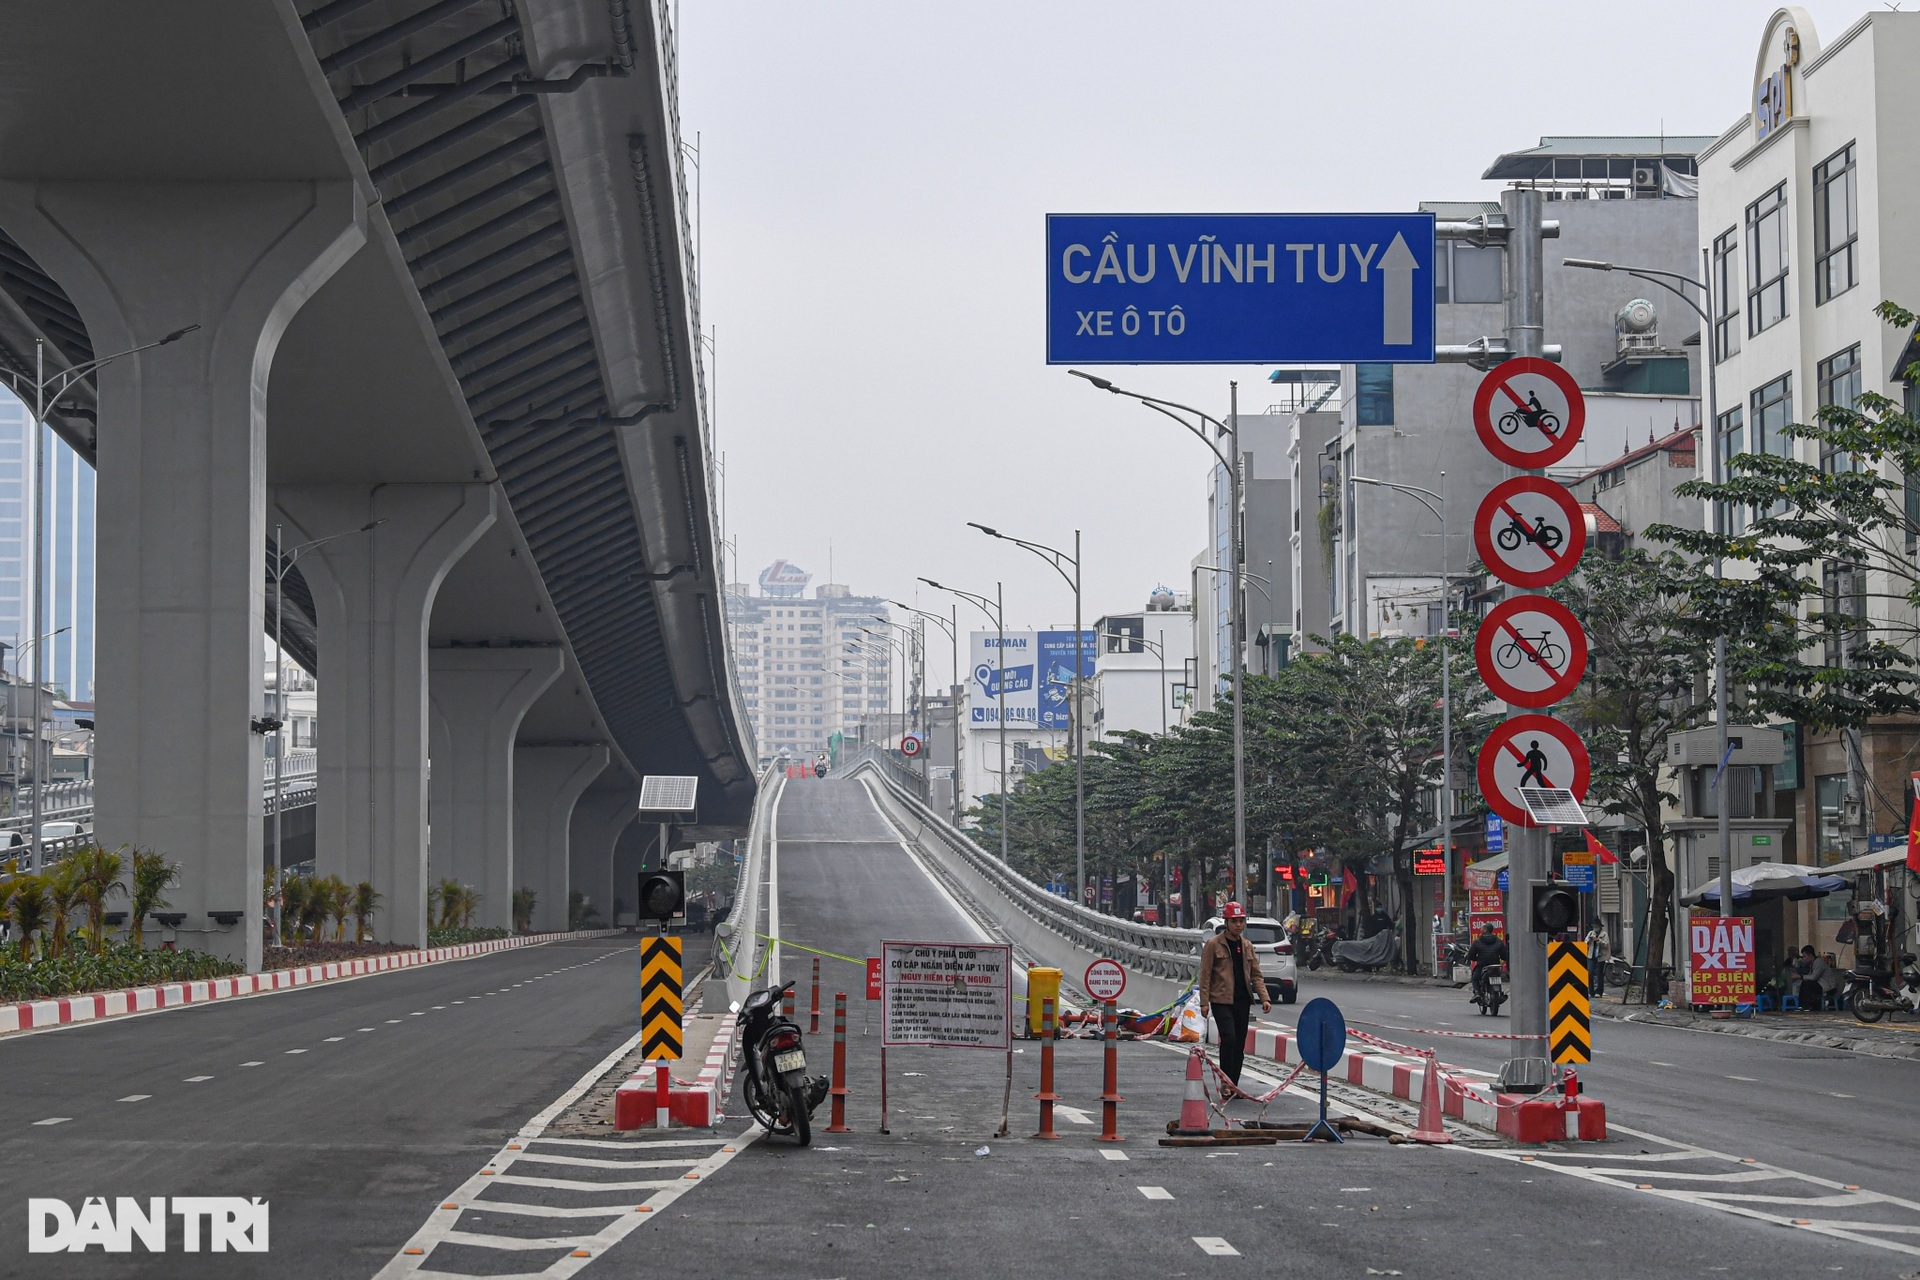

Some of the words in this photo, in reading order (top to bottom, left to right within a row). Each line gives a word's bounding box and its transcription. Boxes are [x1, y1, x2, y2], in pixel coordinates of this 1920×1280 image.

[1062, 231, 1156, 284] CẦU
[1168, 234, 1275, 283] VĨNH
[1286, 243, 1378, 284] TUY
[1076, 311, 1113, 336] XE
[1122, 305, 1140, 336] Ô
[1148, 305, 1186, 336] TÔ
[984, 638, 1027, 648] BIZMAN
[1004, 669, 1017, 680] MỜI
[991, 681, 1013, 692] QUNG
[1015, 678, 1028, 689] CÁO
[906, 742, 915, 751] 60
[1692, 919, 1753, 953] DÁN
[1700, 953, 1747, 969] XE
[901, 972, 921, 981] NGUY
[1692, 971, 1712, 982] ÉP
[1693, 985, 1722, 995] BỌC
[1726, 983, 1755, 994] YÊN
[1708, 995, 1739, 1003] 40K
